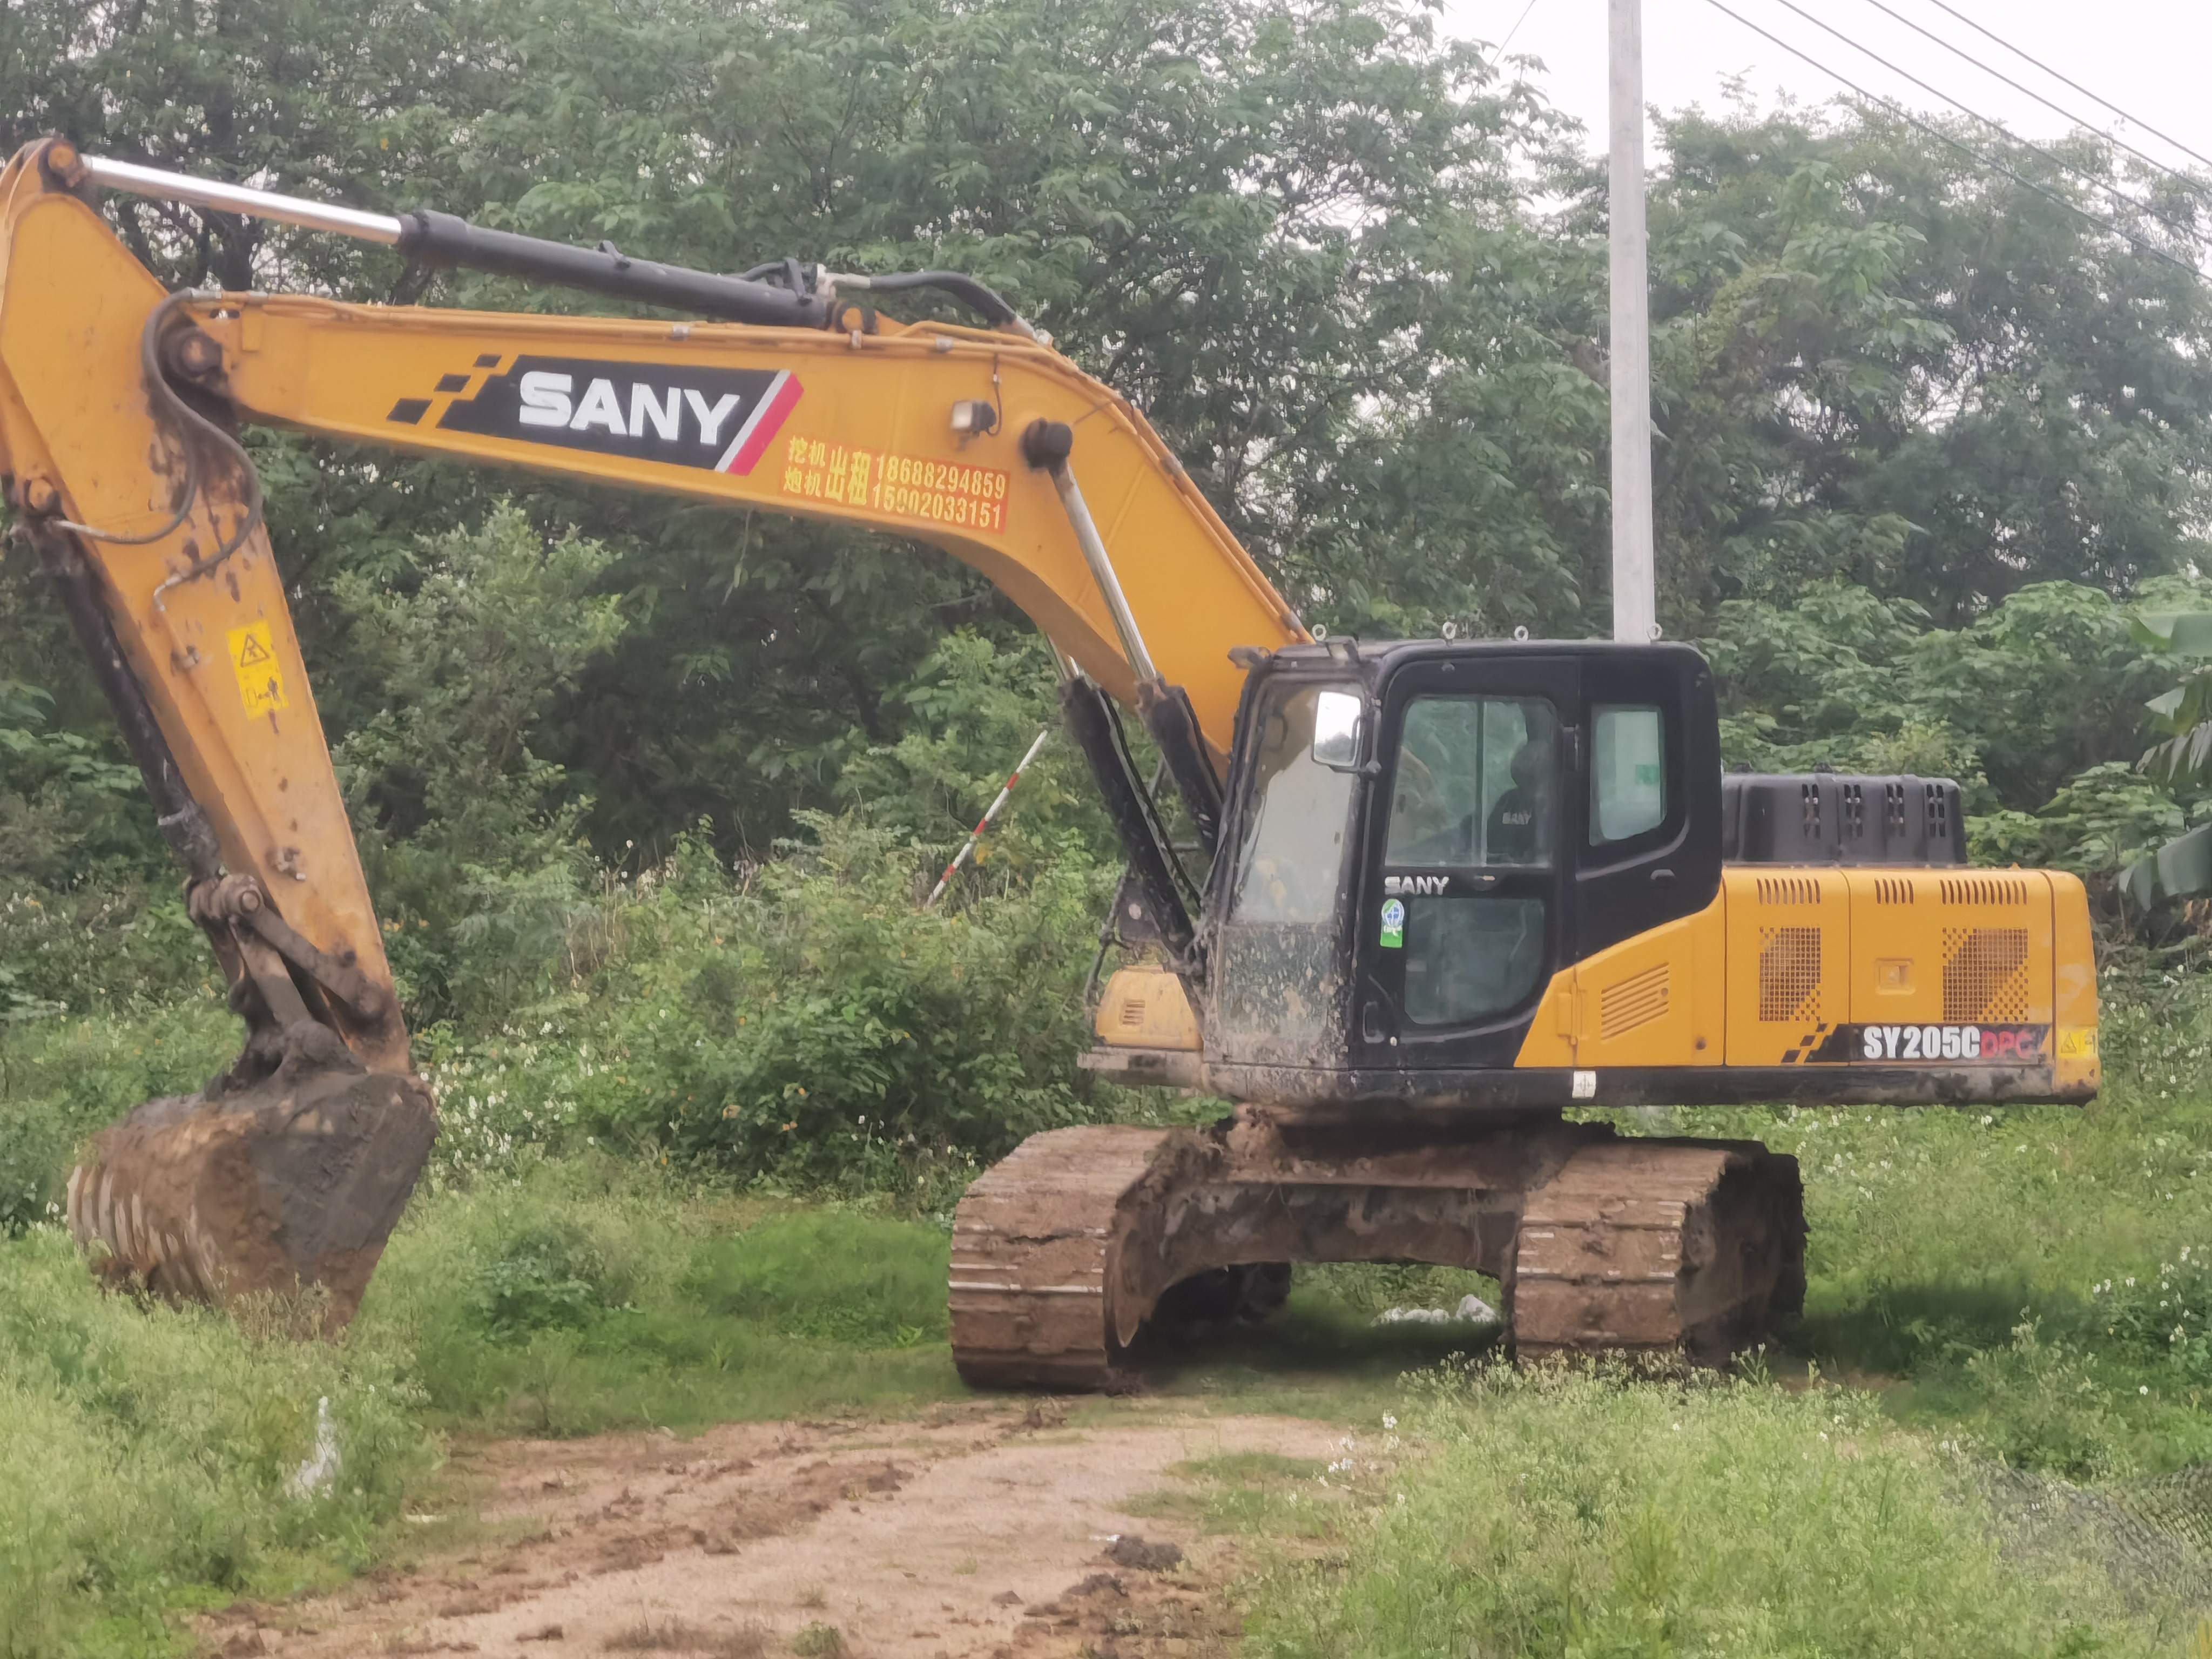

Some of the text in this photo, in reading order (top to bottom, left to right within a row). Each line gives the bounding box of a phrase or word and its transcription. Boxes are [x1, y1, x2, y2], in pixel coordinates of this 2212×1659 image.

[519, 370, 740, 445] SANY
[876, 454, 1006, 499] 18688294859
[1384, 876, 1449, 895] SANY
